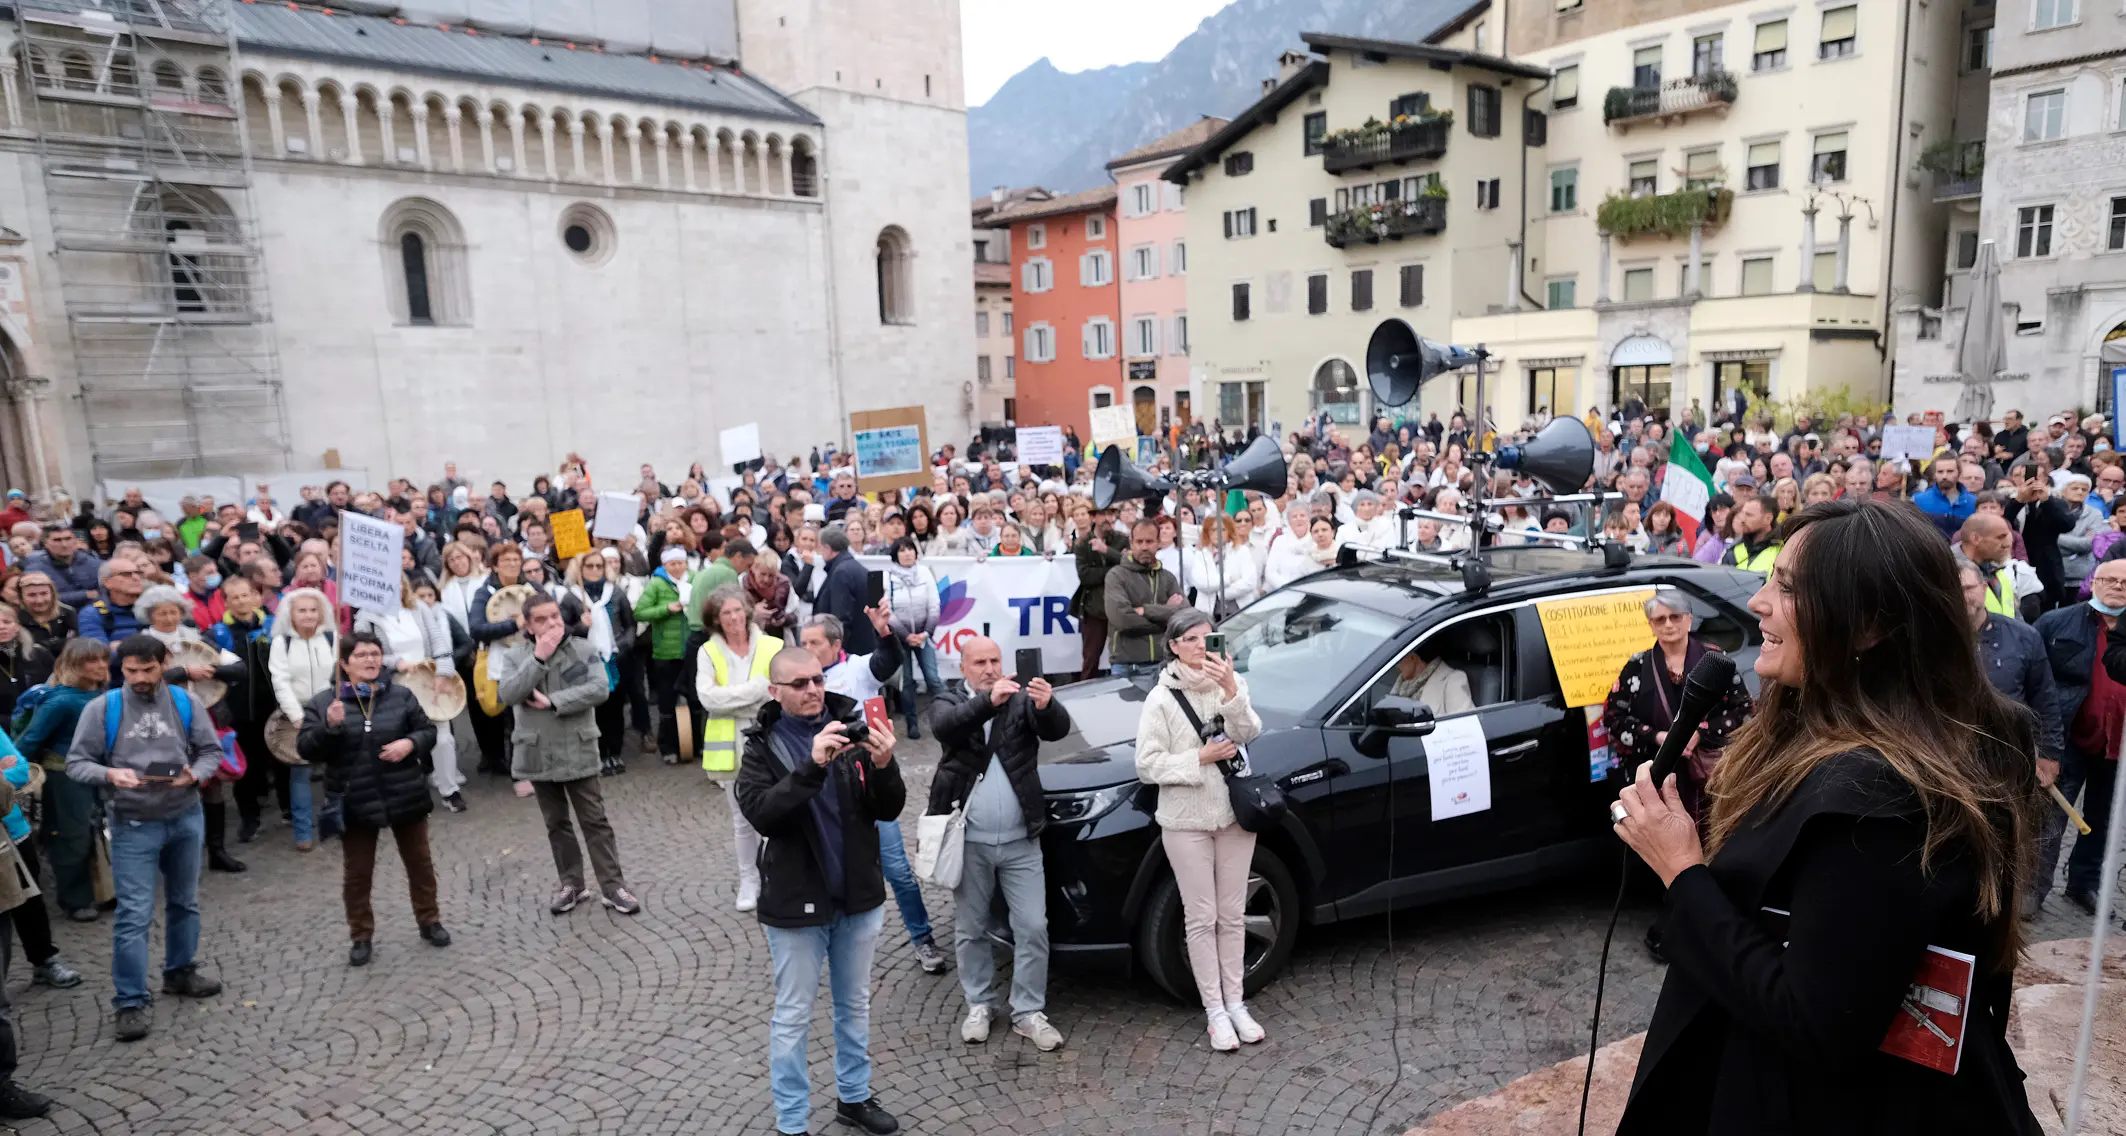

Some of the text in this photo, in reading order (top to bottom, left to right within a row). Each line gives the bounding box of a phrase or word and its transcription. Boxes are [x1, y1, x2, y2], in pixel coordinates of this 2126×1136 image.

[350, 523, 390, 541] LIBERA
[349, 535, 390, 554] SCELTA
[349, 586, 385, 605] ZIONE
[1008, 596, 1082, 637] TR
[1545, 604, 1609, 621] COSTITUZIONE
